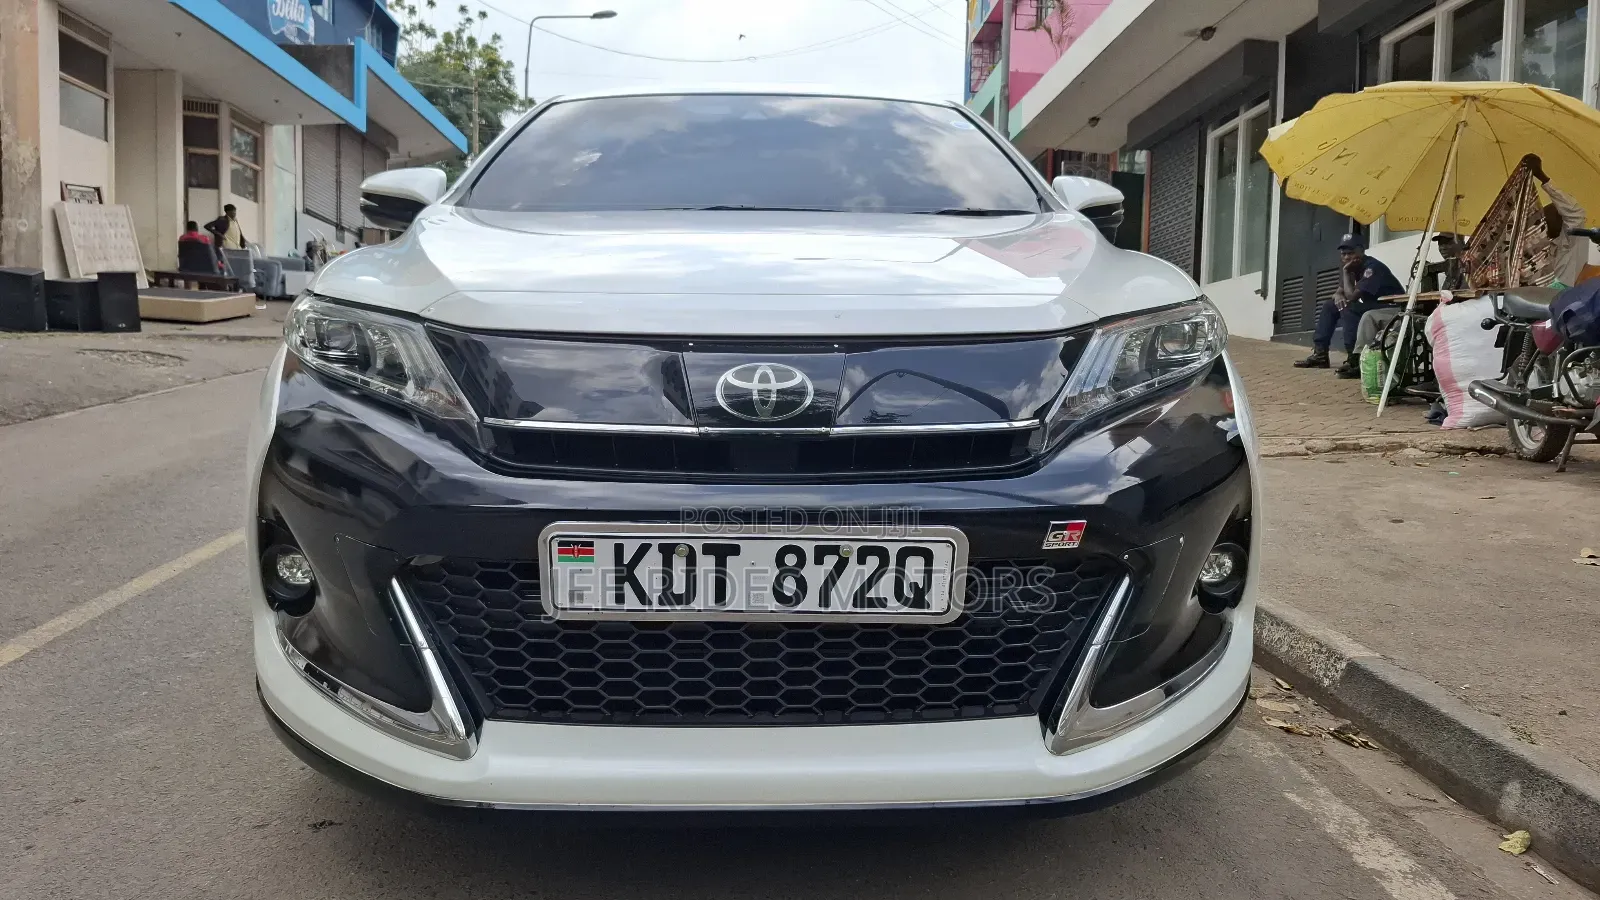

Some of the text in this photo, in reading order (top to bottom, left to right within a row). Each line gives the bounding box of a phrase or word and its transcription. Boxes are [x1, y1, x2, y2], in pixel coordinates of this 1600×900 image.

[1048, 530, 1081, 541] GR
[613, 542, 741, 607] KDT
[772, 544, 934, 610] 872Q
